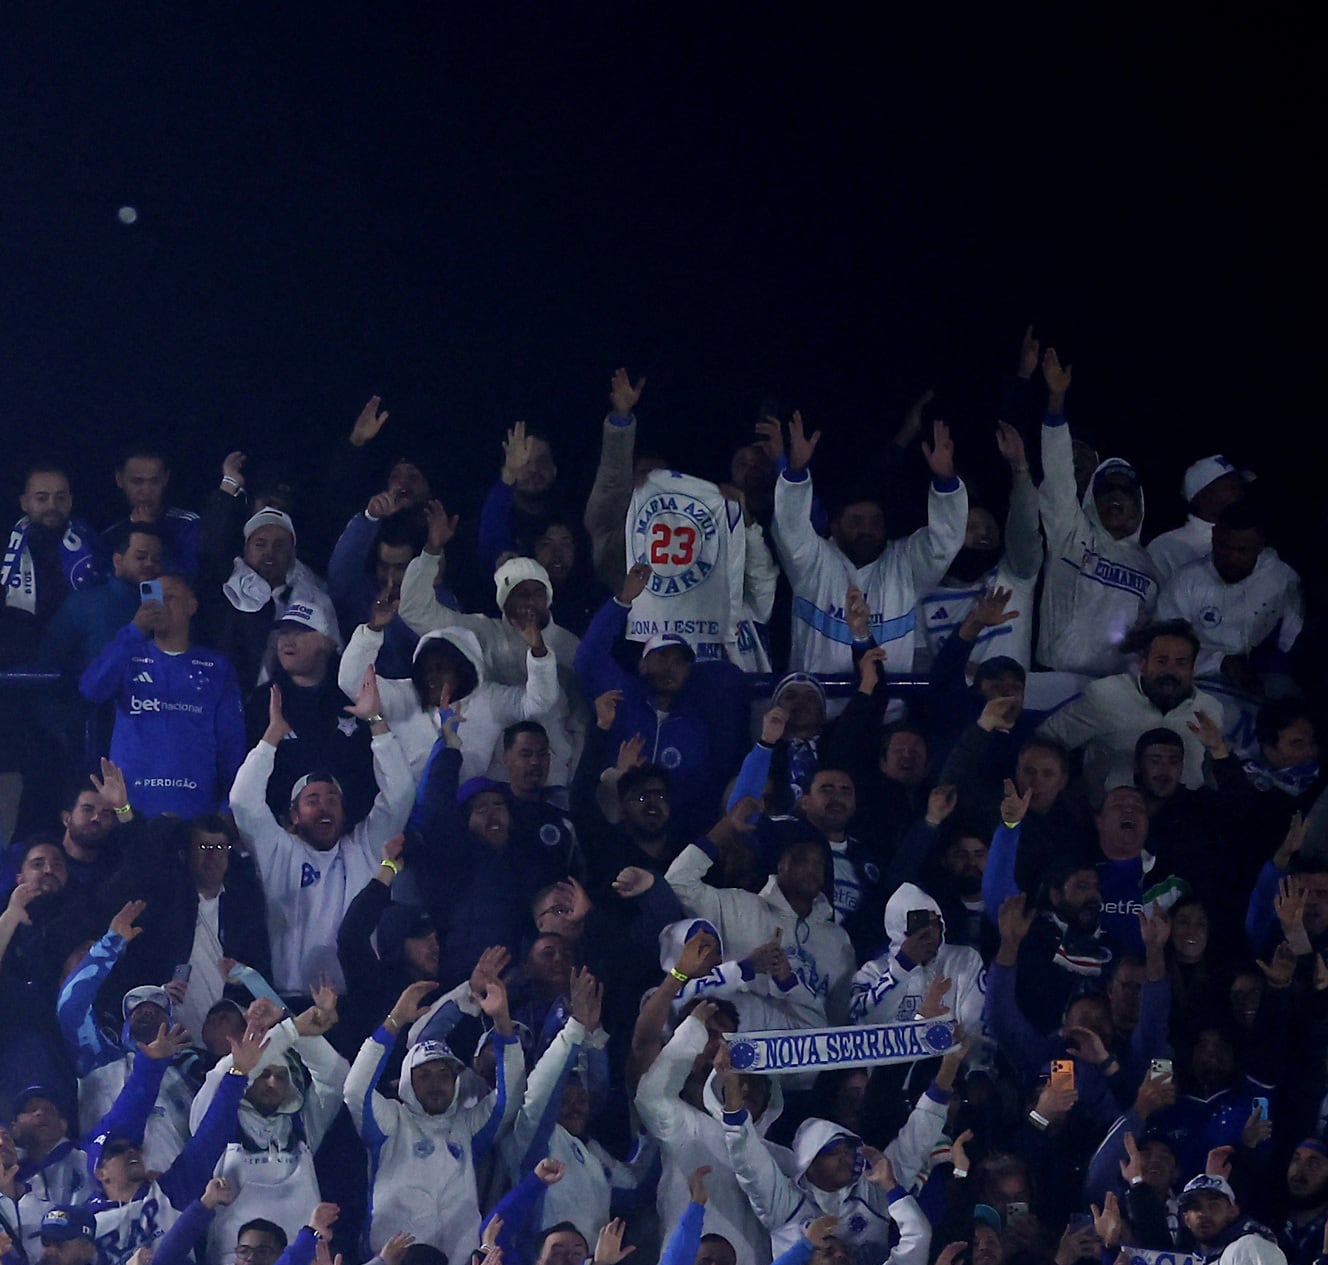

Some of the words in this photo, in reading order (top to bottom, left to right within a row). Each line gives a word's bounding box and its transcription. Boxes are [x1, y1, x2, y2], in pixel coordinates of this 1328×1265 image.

[683, 502, 716, 541] AZUL
[650, 523, 696, 566] 23
[765, 1034, 829, 1070] NOVA
[826, 1024, 931, 1063] SERRANA
